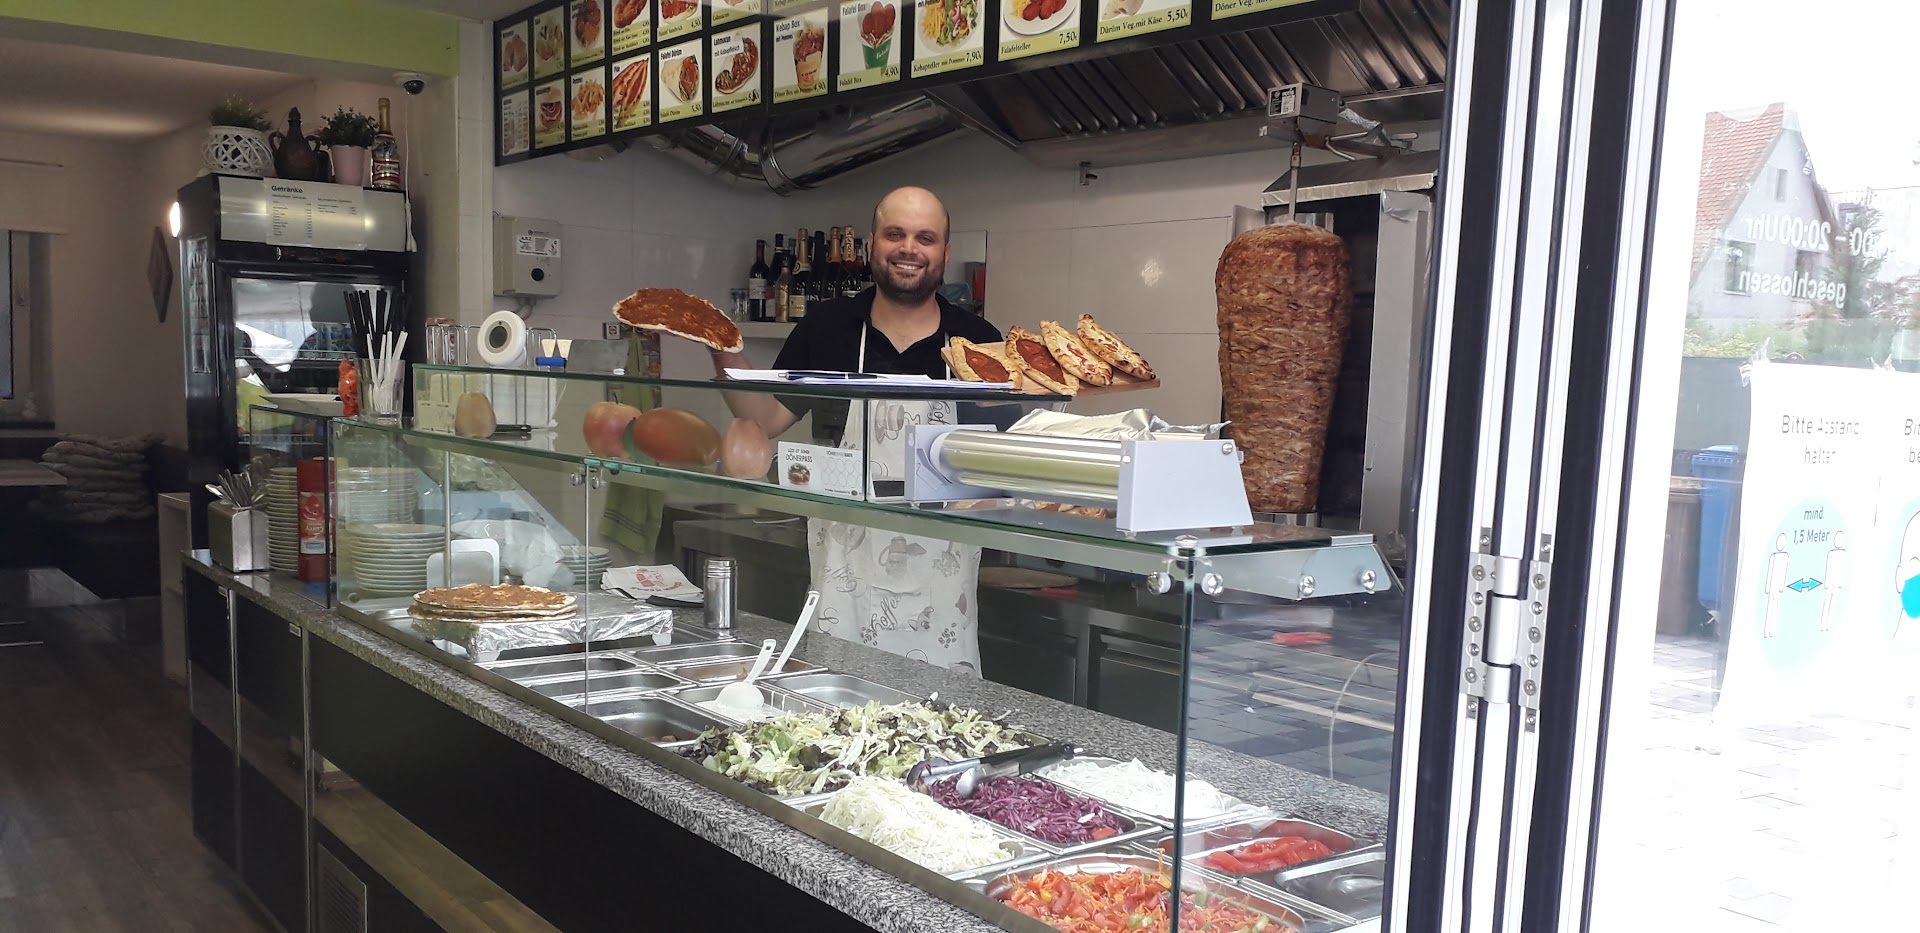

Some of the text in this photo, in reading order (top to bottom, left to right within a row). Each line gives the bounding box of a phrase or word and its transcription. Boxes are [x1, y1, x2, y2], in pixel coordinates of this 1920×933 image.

[842, 4, 866, 16] Falafel Box
[1215, 2, 1236, 11] Döner
[776, 22, 790, 32] Kebap
[1100, 25, 1121, 34] Dürüm
[1147, 16, 1162, 24] Käse
[714, 36, 731, 46] Lahmacun
[1001, 42, 1031, 54] Falafelteller
[660, 52, 671, 60] Falafel
[913, 61, 940, 72] Kebapteller
[272, 186, 303, 194] Getränke
[1782, 414, 1813, 434] Bitte
[786, 453, 812, 463] DÖNERPASS
[1804, 506, 1825, 520] mind.
[1793, 530, 1830, 546] 1,5 Meter
